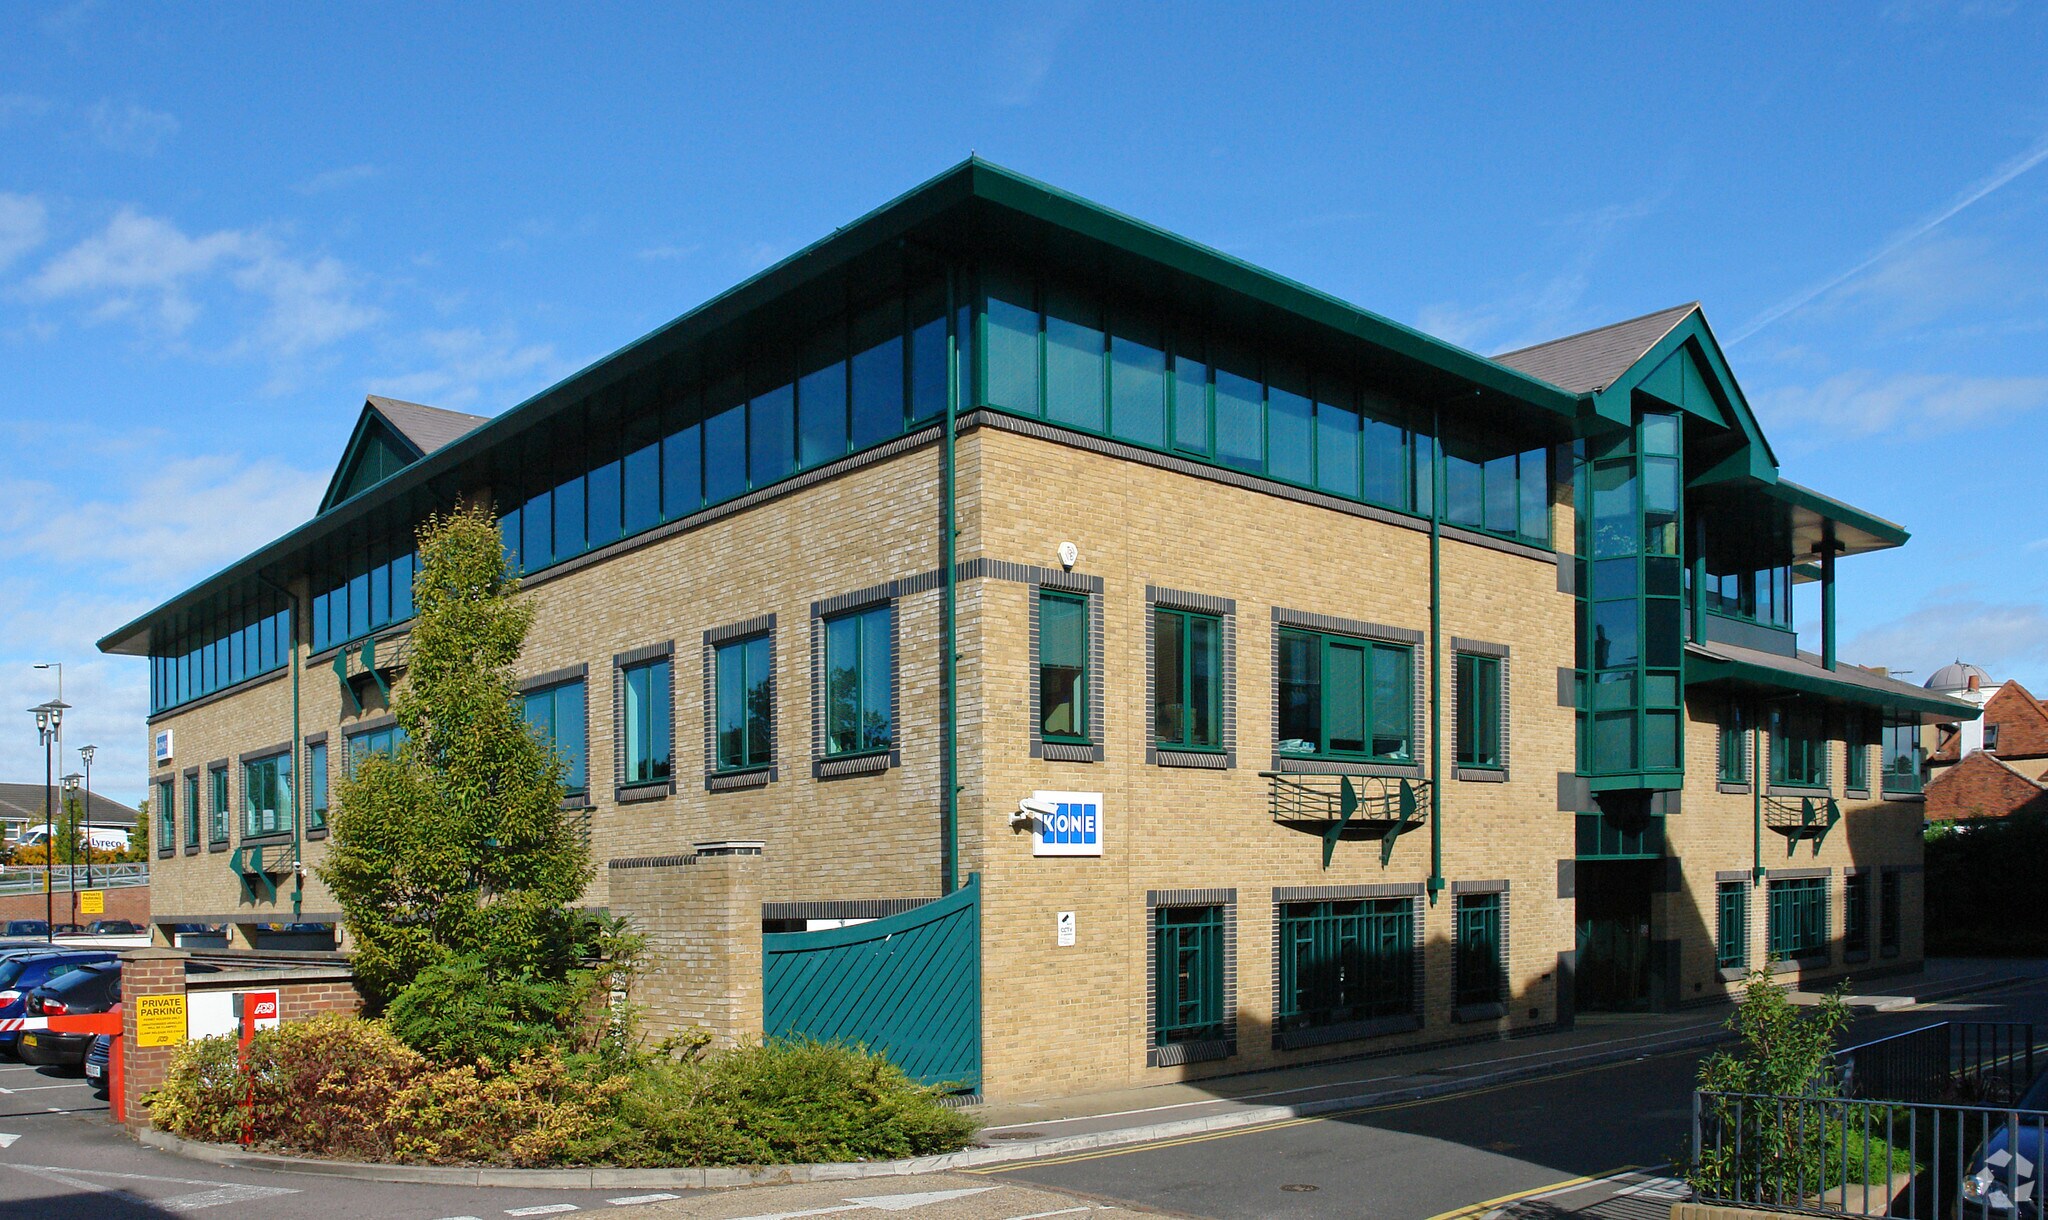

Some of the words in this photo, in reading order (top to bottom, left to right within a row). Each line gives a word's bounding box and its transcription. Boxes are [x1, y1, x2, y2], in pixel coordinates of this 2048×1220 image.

[1043, 815, 1095, 832] KONE
[91, 838, 122, 847] Lyreco
[142, 998, 181, 1007] PRIVATE
[140, 1007, 183, 1016] PARKING
